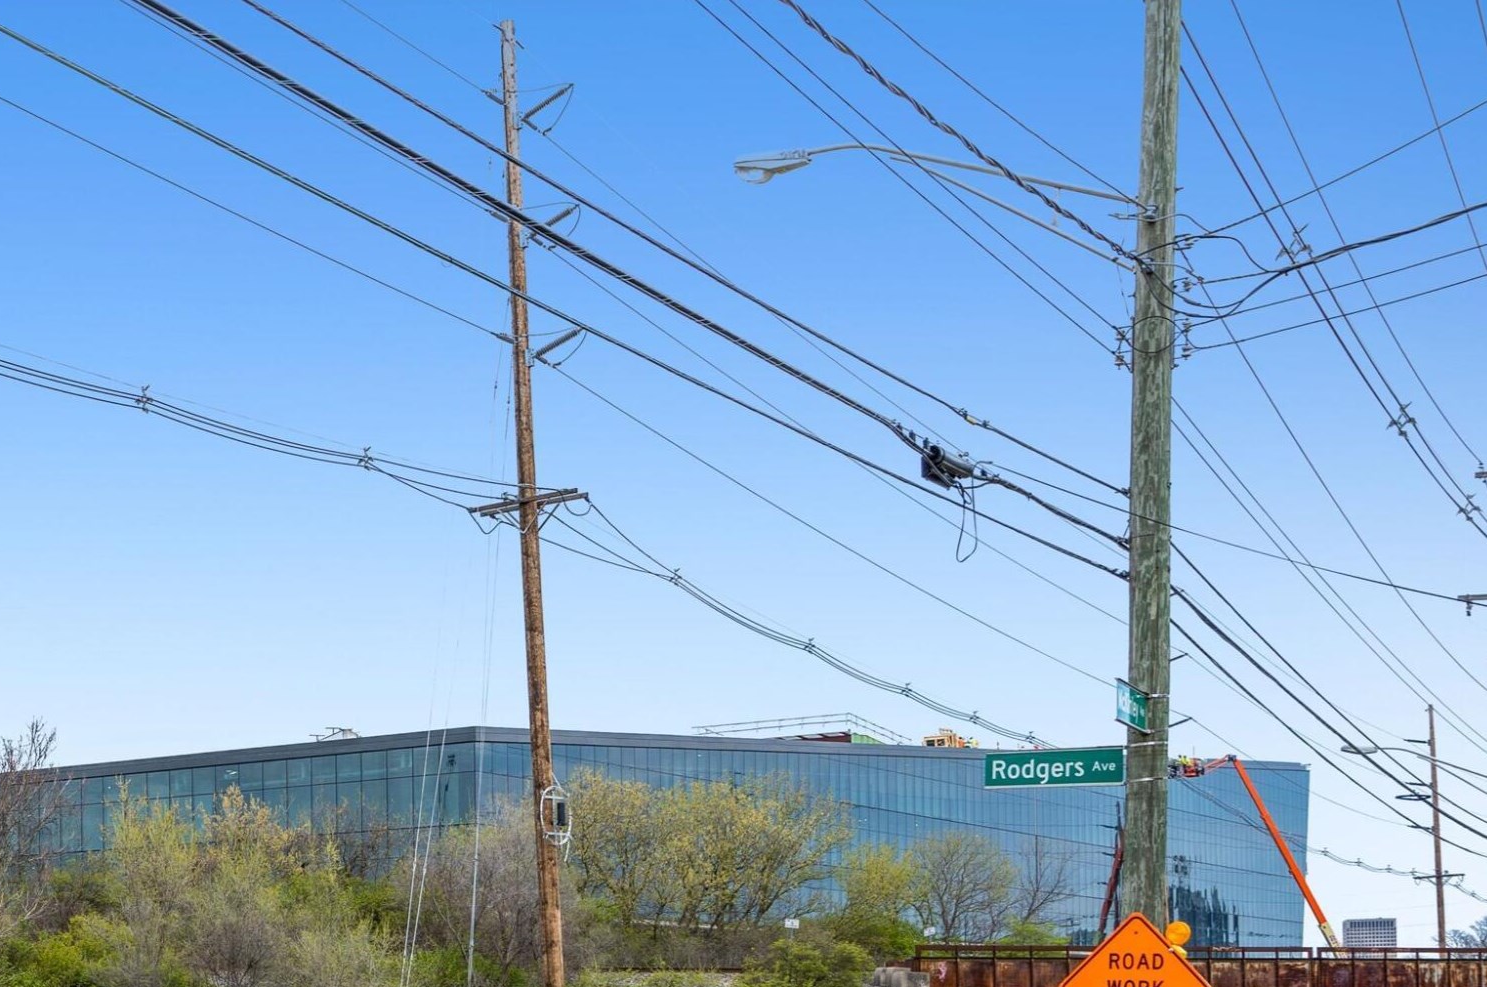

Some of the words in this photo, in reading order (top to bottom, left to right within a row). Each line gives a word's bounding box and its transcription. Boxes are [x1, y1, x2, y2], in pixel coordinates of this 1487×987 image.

[991, 758, 1085, 784] Rodgers
[1091, 760, 1117, 772] Ave
[1108, 952, 1164, 970] ROAD
